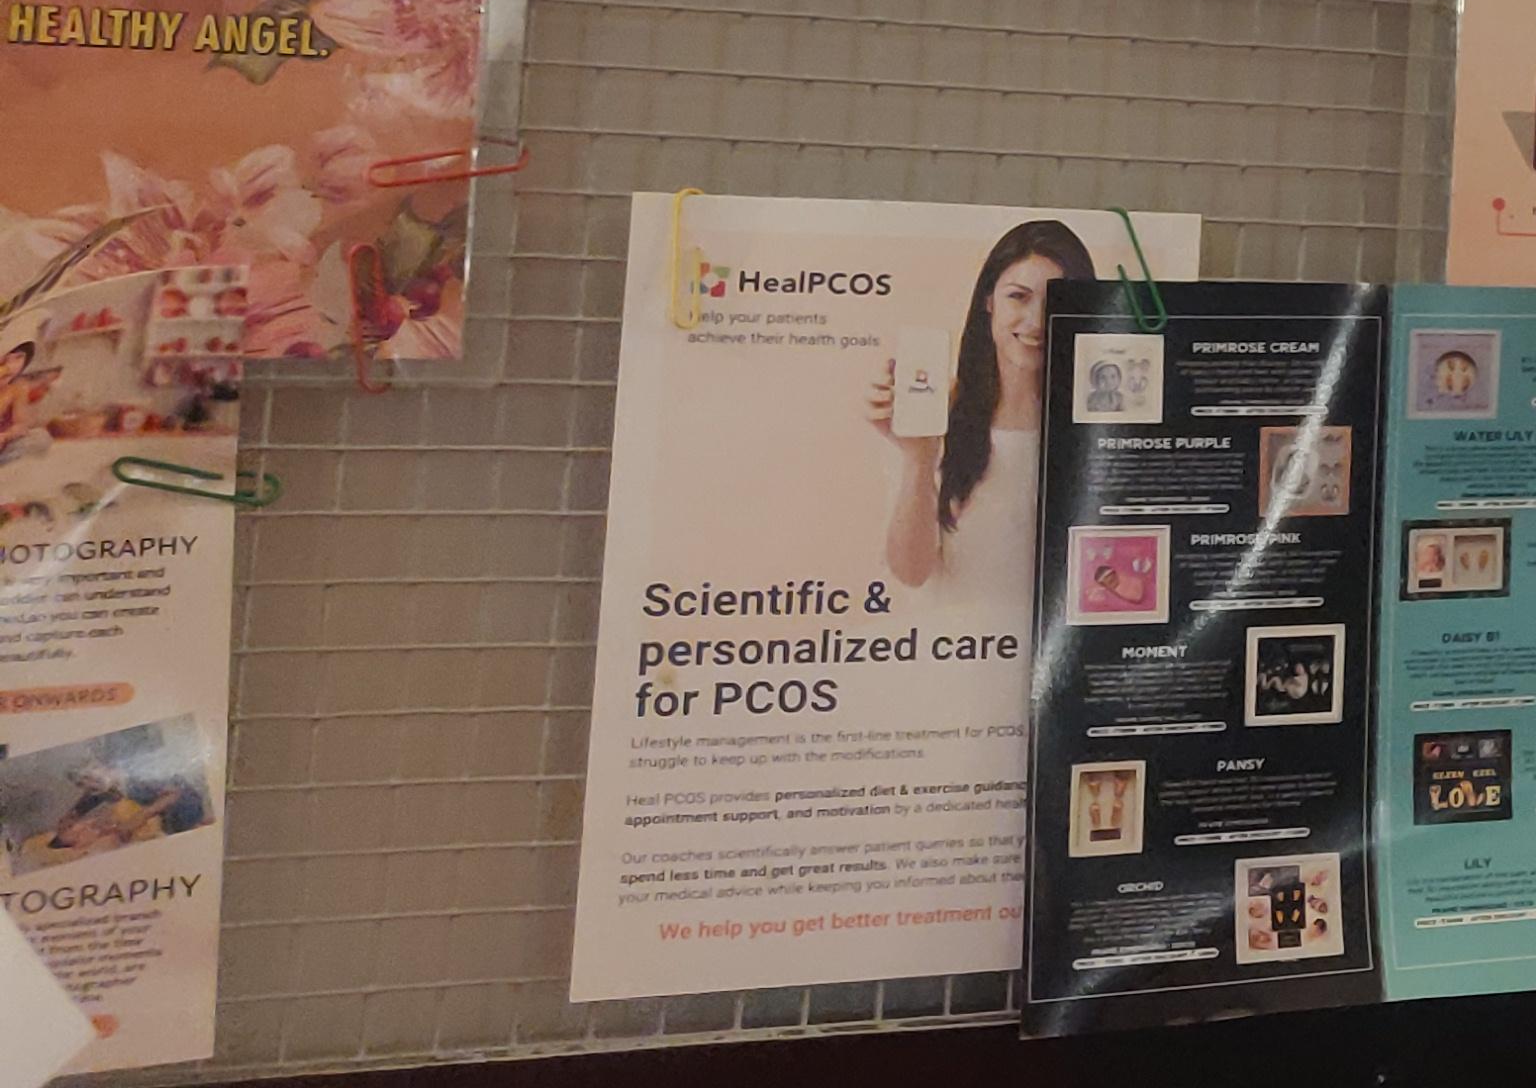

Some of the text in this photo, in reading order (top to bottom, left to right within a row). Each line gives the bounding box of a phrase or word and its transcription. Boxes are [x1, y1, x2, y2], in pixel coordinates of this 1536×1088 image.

[8, 4, 330, 59] HEALTHY ANGEL.
[738, 269, 893, 297] HealPCOS
[750, 332, 880, 348] their health goals
[1193, 342, 1319, 353] PRIMROSE CREAM
[1098, 437, 1231, 449] PRIMROSE PURPLE
[642, 579, 892, 617] Scientific &
[639, 628, 1018, 675] personalized care
[1122, 646, 1187, 658] MOMENT
[635, 679, 839, 718] for PCOS
[1217, 759, 1265, 772] PANSY
[660, 905, 992, 940] We help you get better treatment
